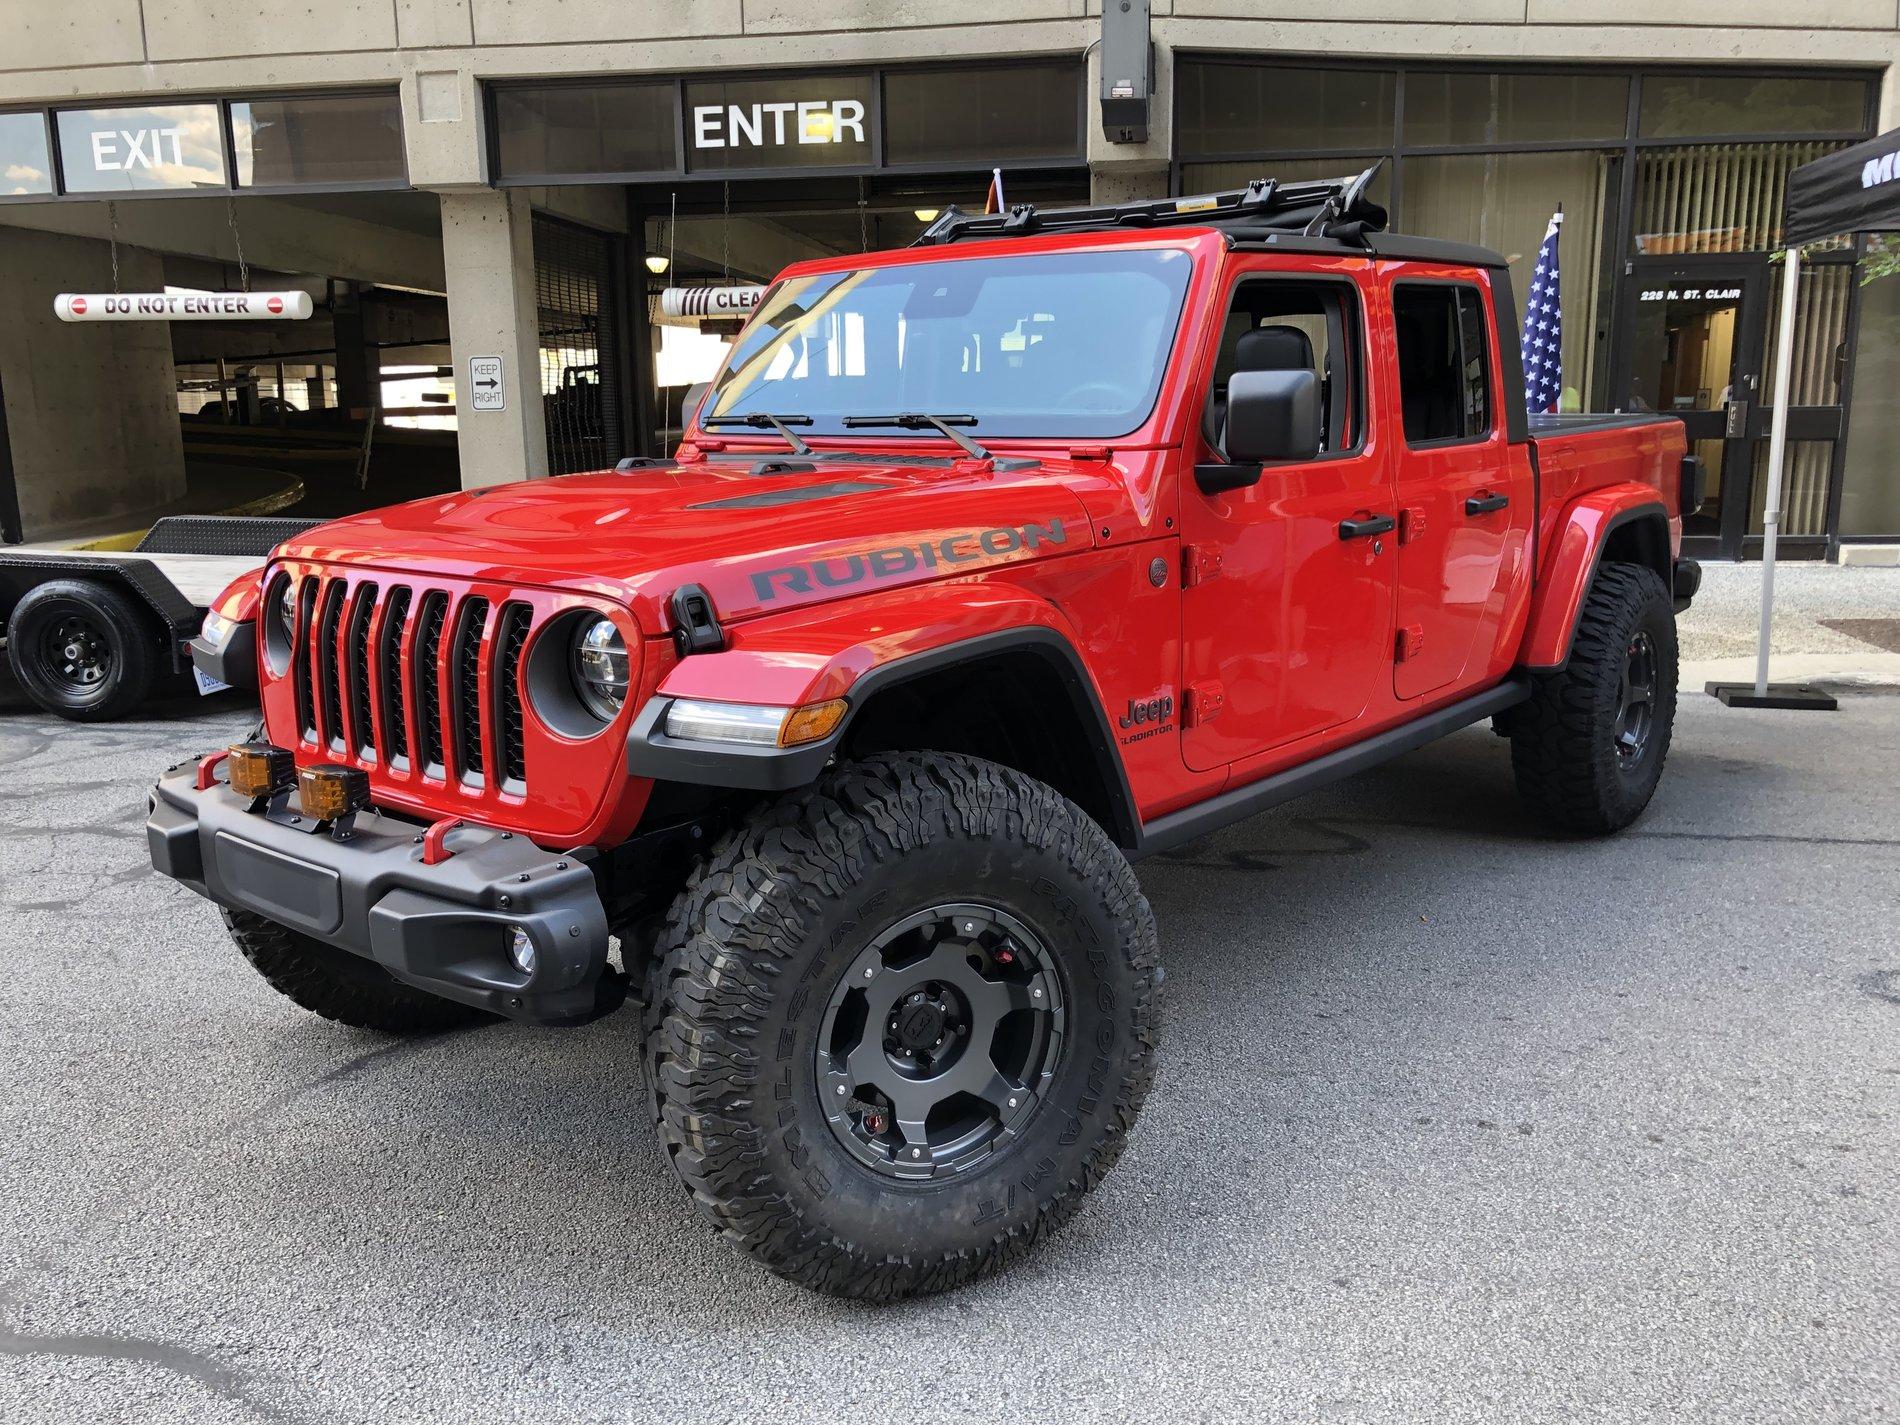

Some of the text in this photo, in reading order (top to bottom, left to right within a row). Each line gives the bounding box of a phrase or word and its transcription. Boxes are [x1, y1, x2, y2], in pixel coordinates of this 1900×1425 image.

[694, 100, 865, 148] ENTER
[91, 128, 189, 170] EXIT
[104, 296, 250, 314] DO NOT ENTER
[1640, 289, 1741, 300] 225 N. ST. CLAIR
[474, 364, 498, 375] KEEP
[474, 391, 501, 403] RIGHT
[1728, 406, 1736, 433] PULL
[750, 517, 1067, 601] RUBICON
[1119, 695, 1173, 729] Jeep
[1030, 874, 1118, 1146] PATAGONIA
